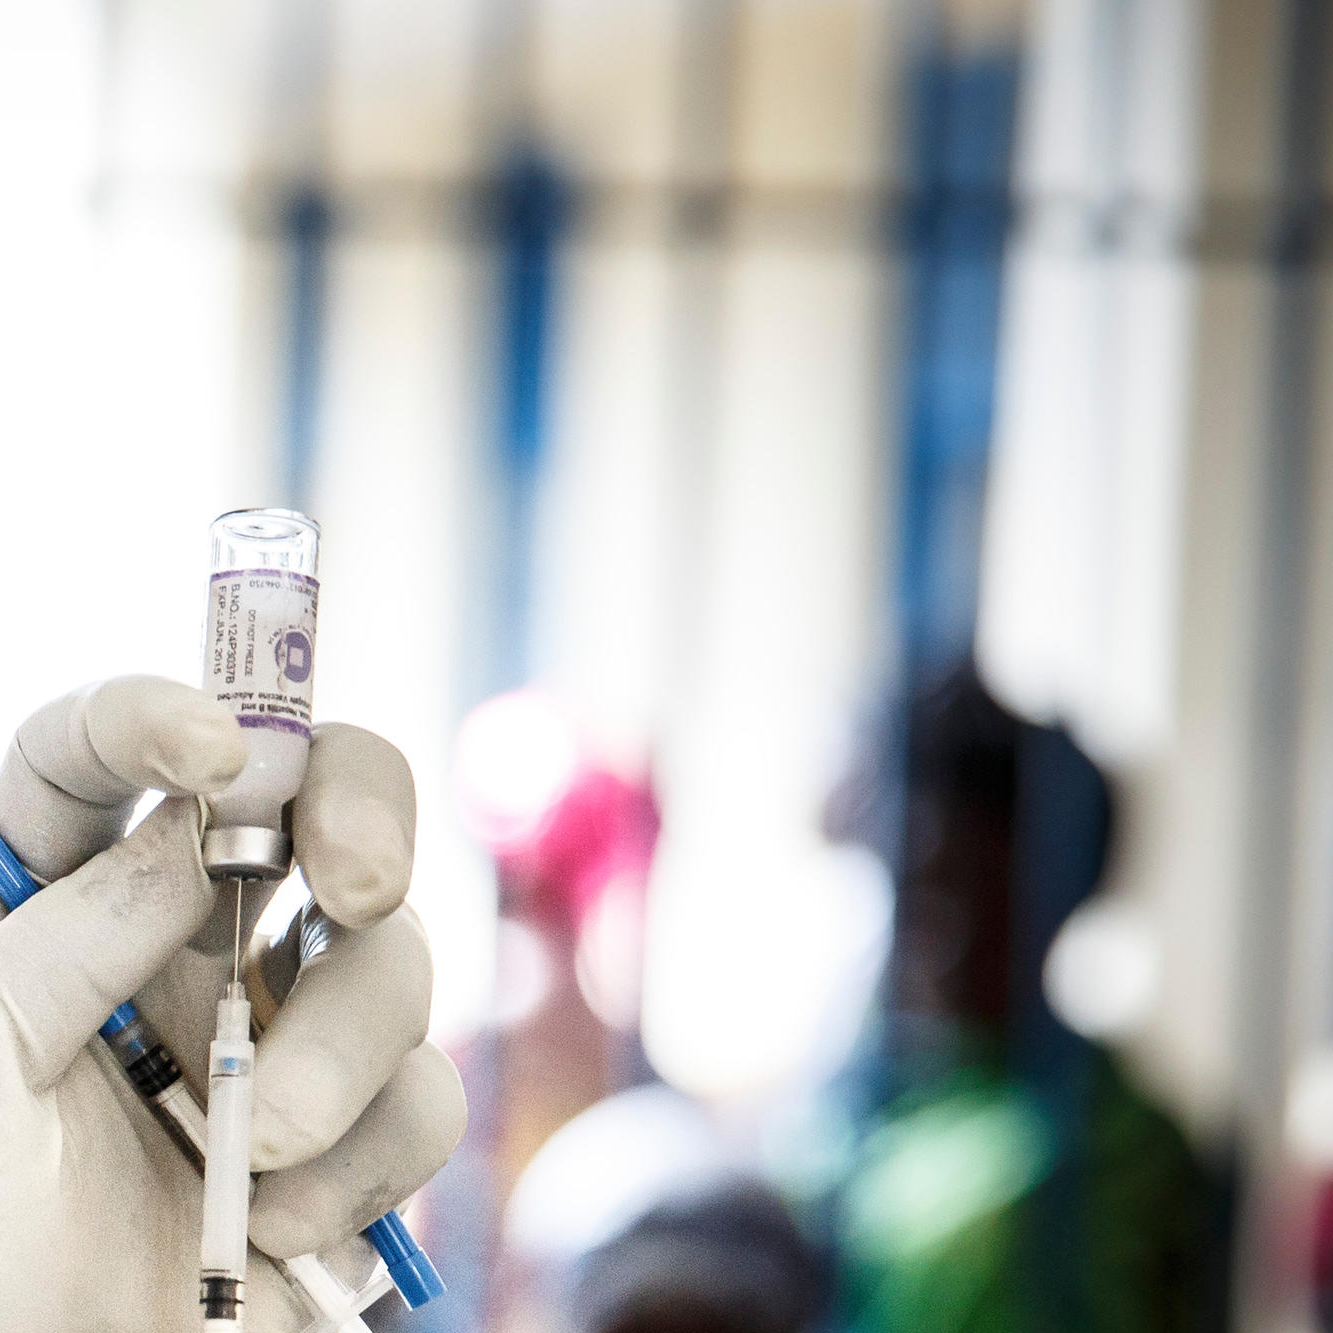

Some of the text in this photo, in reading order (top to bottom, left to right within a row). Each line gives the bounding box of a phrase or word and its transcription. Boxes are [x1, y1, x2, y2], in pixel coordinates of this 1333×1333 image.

[244, 609, 256, 677] DO NOT FREEZE
[213, 648, 223, 675] 2015
[225, 623, 238, 684] 124P3037B
[258, 692, 288, 702] Vaccine
[241, 703, 257, 711] and
[259, 703, 265, 712] B
